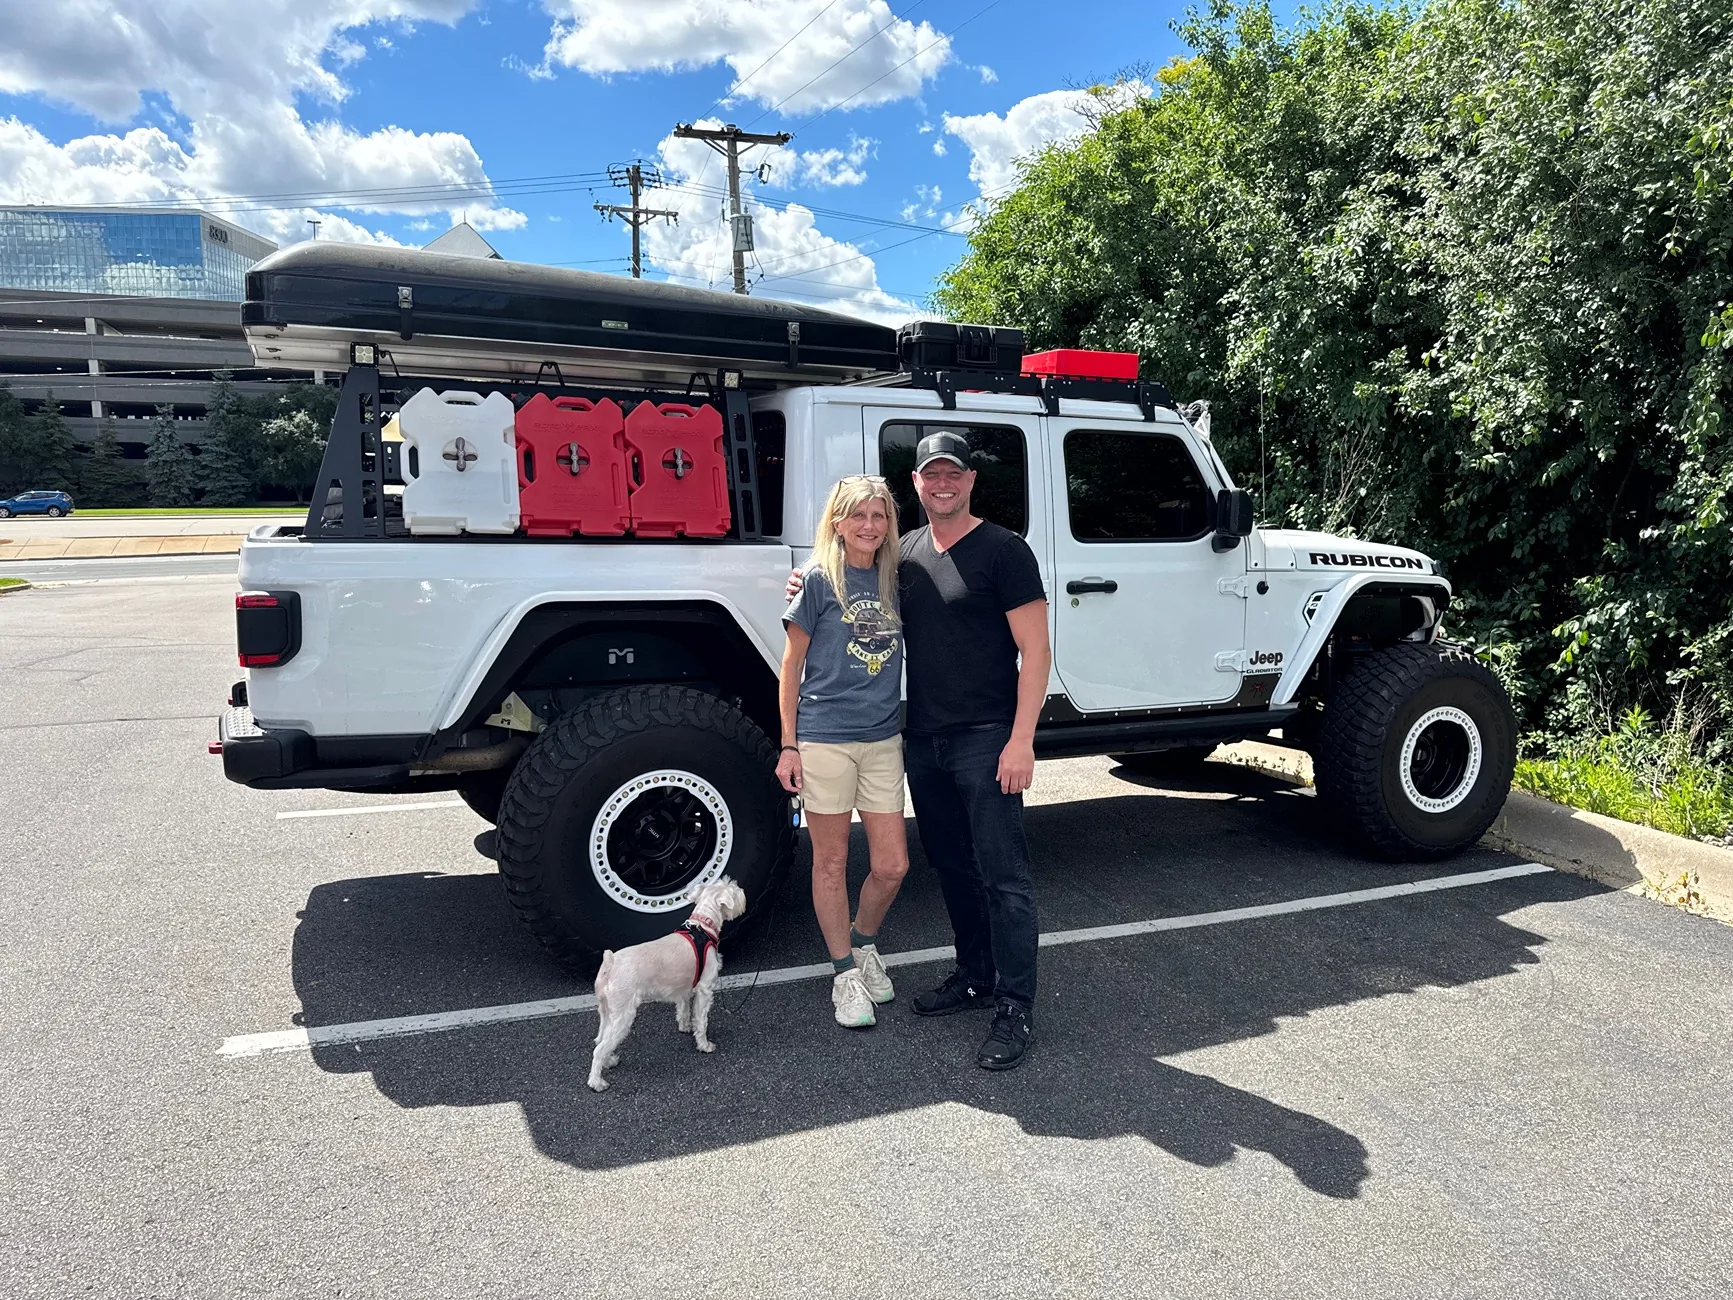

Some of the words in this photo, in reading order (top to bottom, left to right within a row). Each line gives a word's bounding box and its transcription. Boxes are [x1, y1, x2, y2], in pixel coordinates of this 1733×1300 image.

[1309, 552, 1424, 570] RUBICON
[849, 601, 876, 617] ROUTE
[852, 644, 869, 660] TAKE
[882, 643, 896, 659] EASY
[1249, 650, 1284, 666] Jeep
[870, 665, 880, 674] 66
